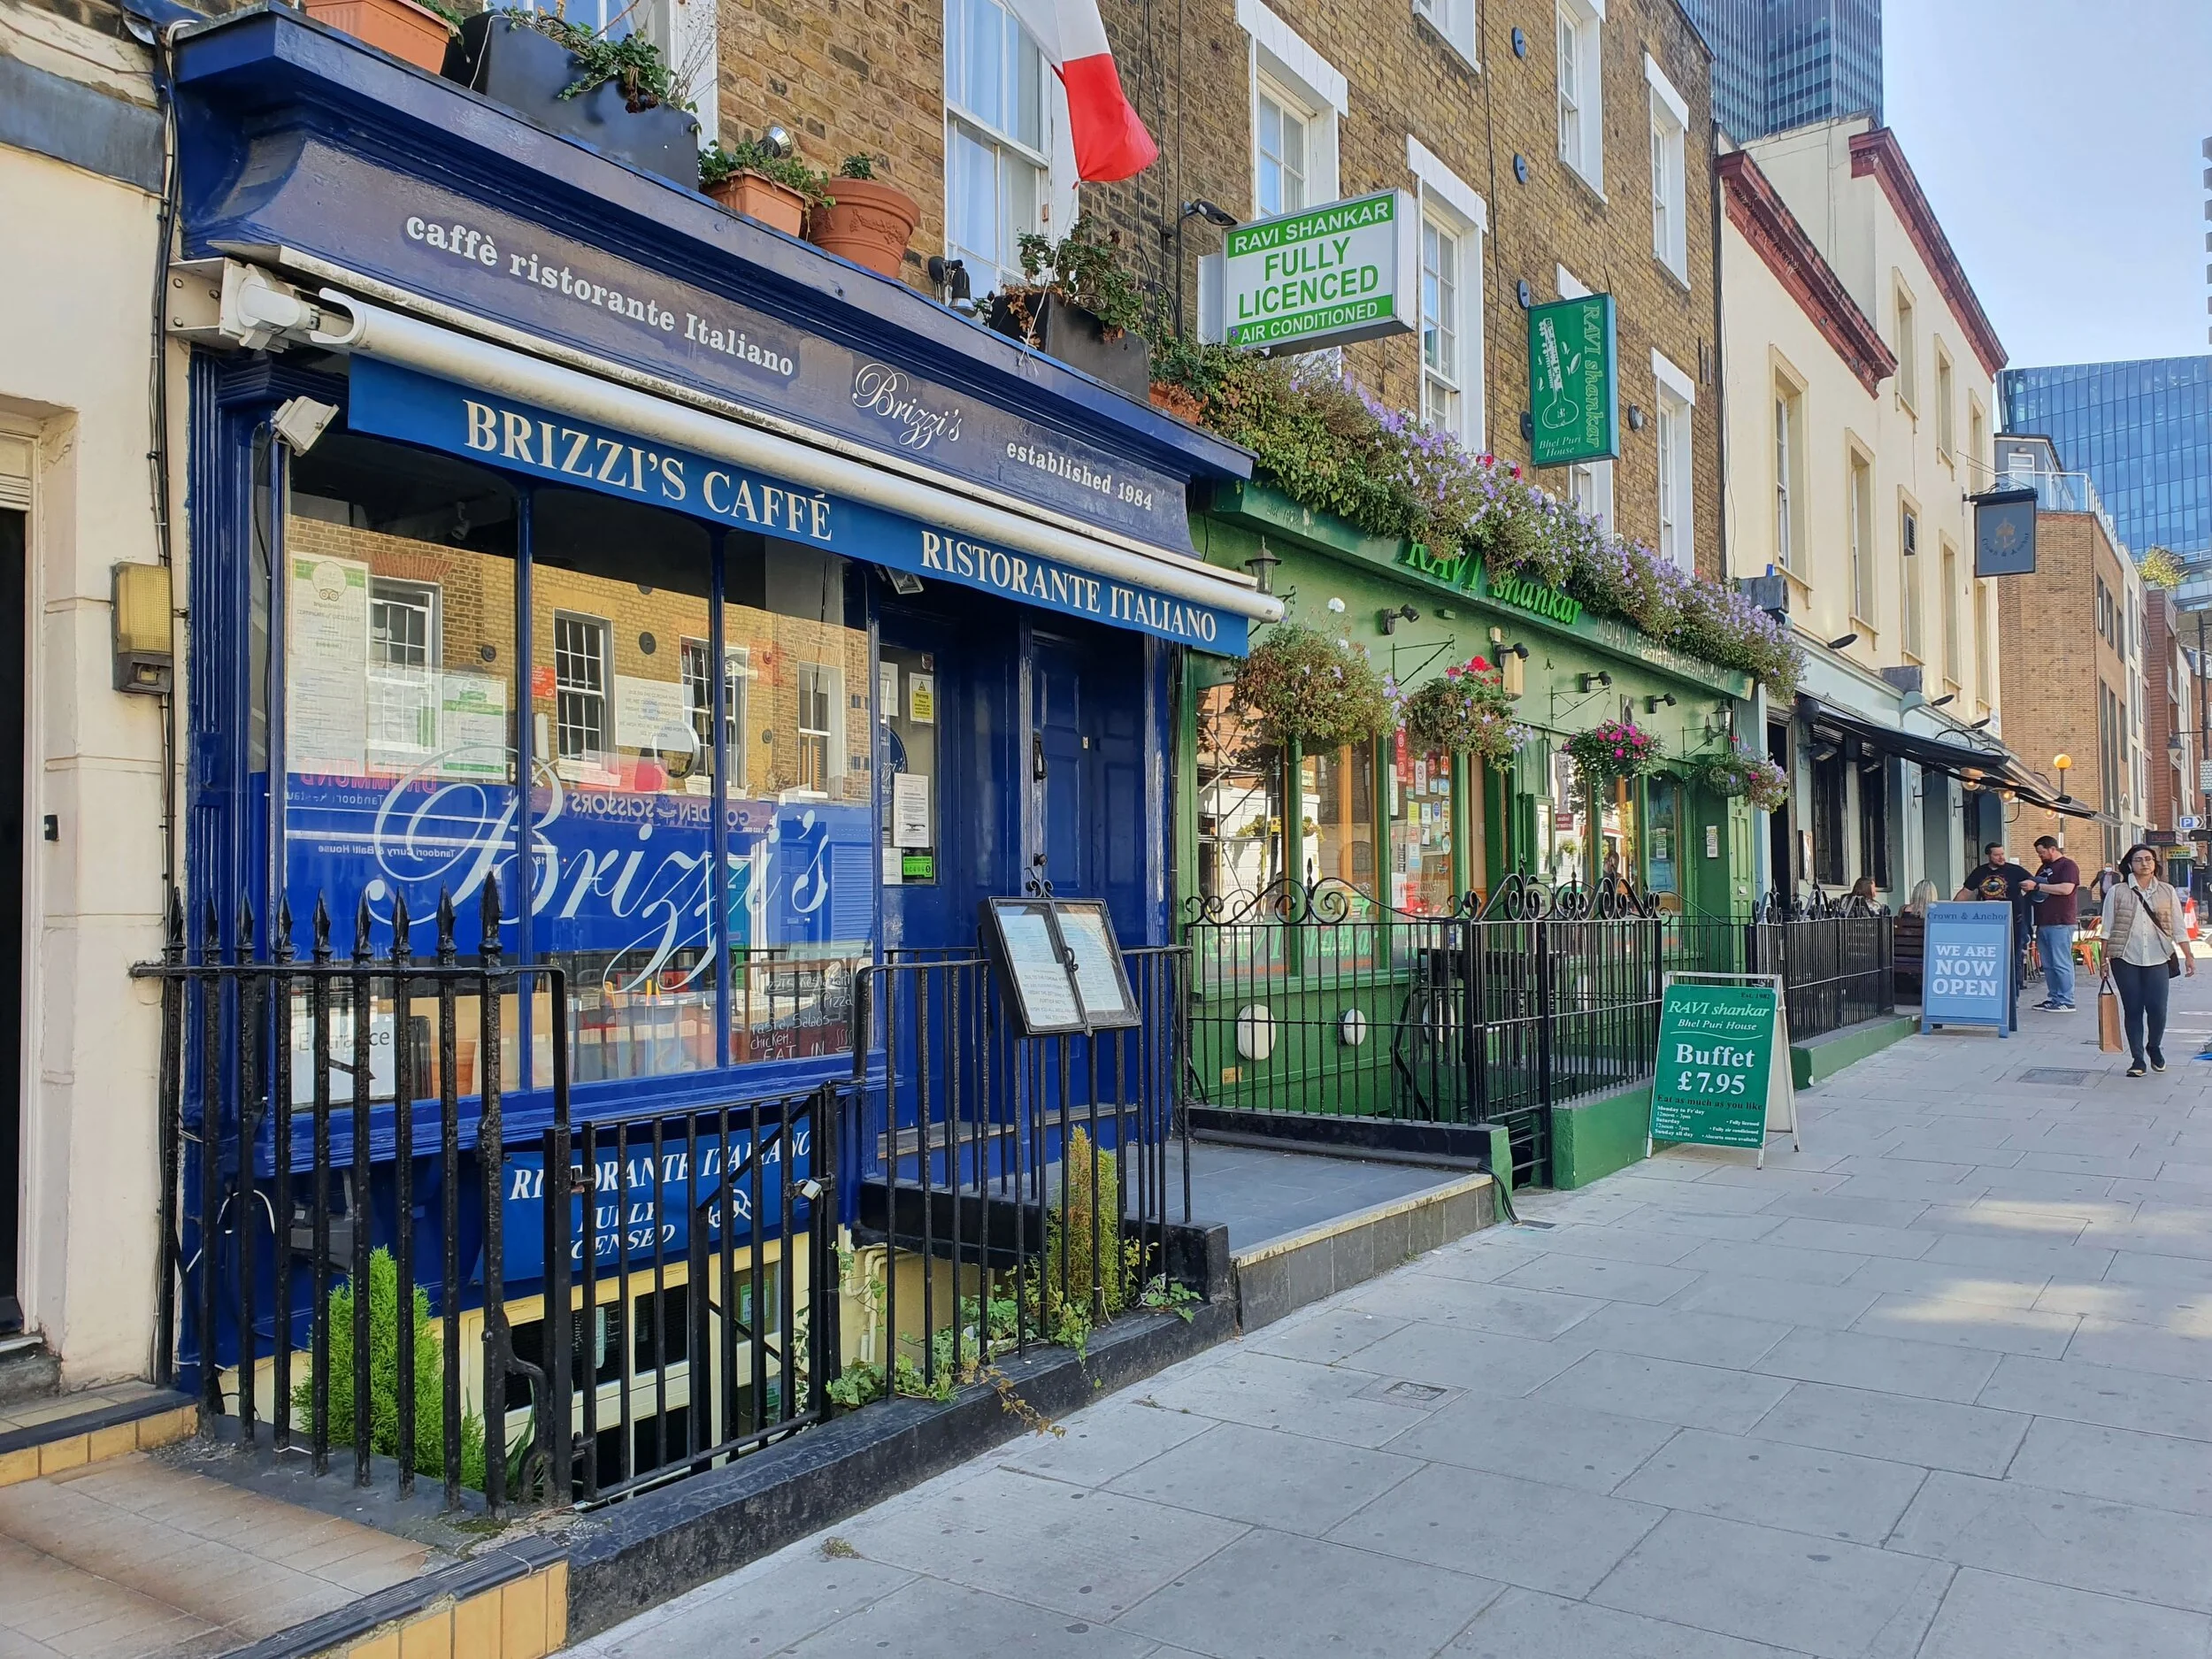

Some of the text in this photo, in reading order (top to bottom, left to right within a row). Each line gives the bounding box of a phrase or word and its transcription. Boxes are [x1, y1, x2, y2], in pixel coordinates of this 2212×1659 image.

[1235, 202, 1389, 254] RAVI SHANKAR
[1264, 236, 1351, 281] FULLY
[406, 216, 795, 377] caffè ristorante Italiano
[1239, 265, 1379, 319] LICENCED
[1240, 303, 1378, 344] AIR CONDITIONED
[1584, 304, 1604, 448] RAVI shankar
[851, 363, 963, 449] Brizzi's
[1539, 434, 1581, 449] Bhel Puri
[1546, 446, 1575, 457] House
[462, 398, 833, 541] BRIZZI'S CAFFÉ
[1006, 441, 1153, 511] established 1984
[920, 530, 1217, 642] RISTORANTE ITALIANO
[1596, 618, 1628, 646] INDIAN
[366, 744, 829, 993] Brizzi's
[1972, 912, 2008, 921] Anchor
[1934, 959, 1997, 977] NOW
[1935, 945, 1996, 957] WE ARE
[1932, 978, 1998, 996] OPEN
[1667, 1001, 1770, 1018] RAVI shankar
[1678, 1018, 1757, 1031] Bhel Puri House
[298, 1031, 390, 1051] Erace
[1674, 1042, 1755, 1068] Buffet
[1687, 1097, 1712, 1107] much
[1746, 1102, 1763, 1110] like
[509, 1130, 811, 1201] RIRANTE ITAANO
